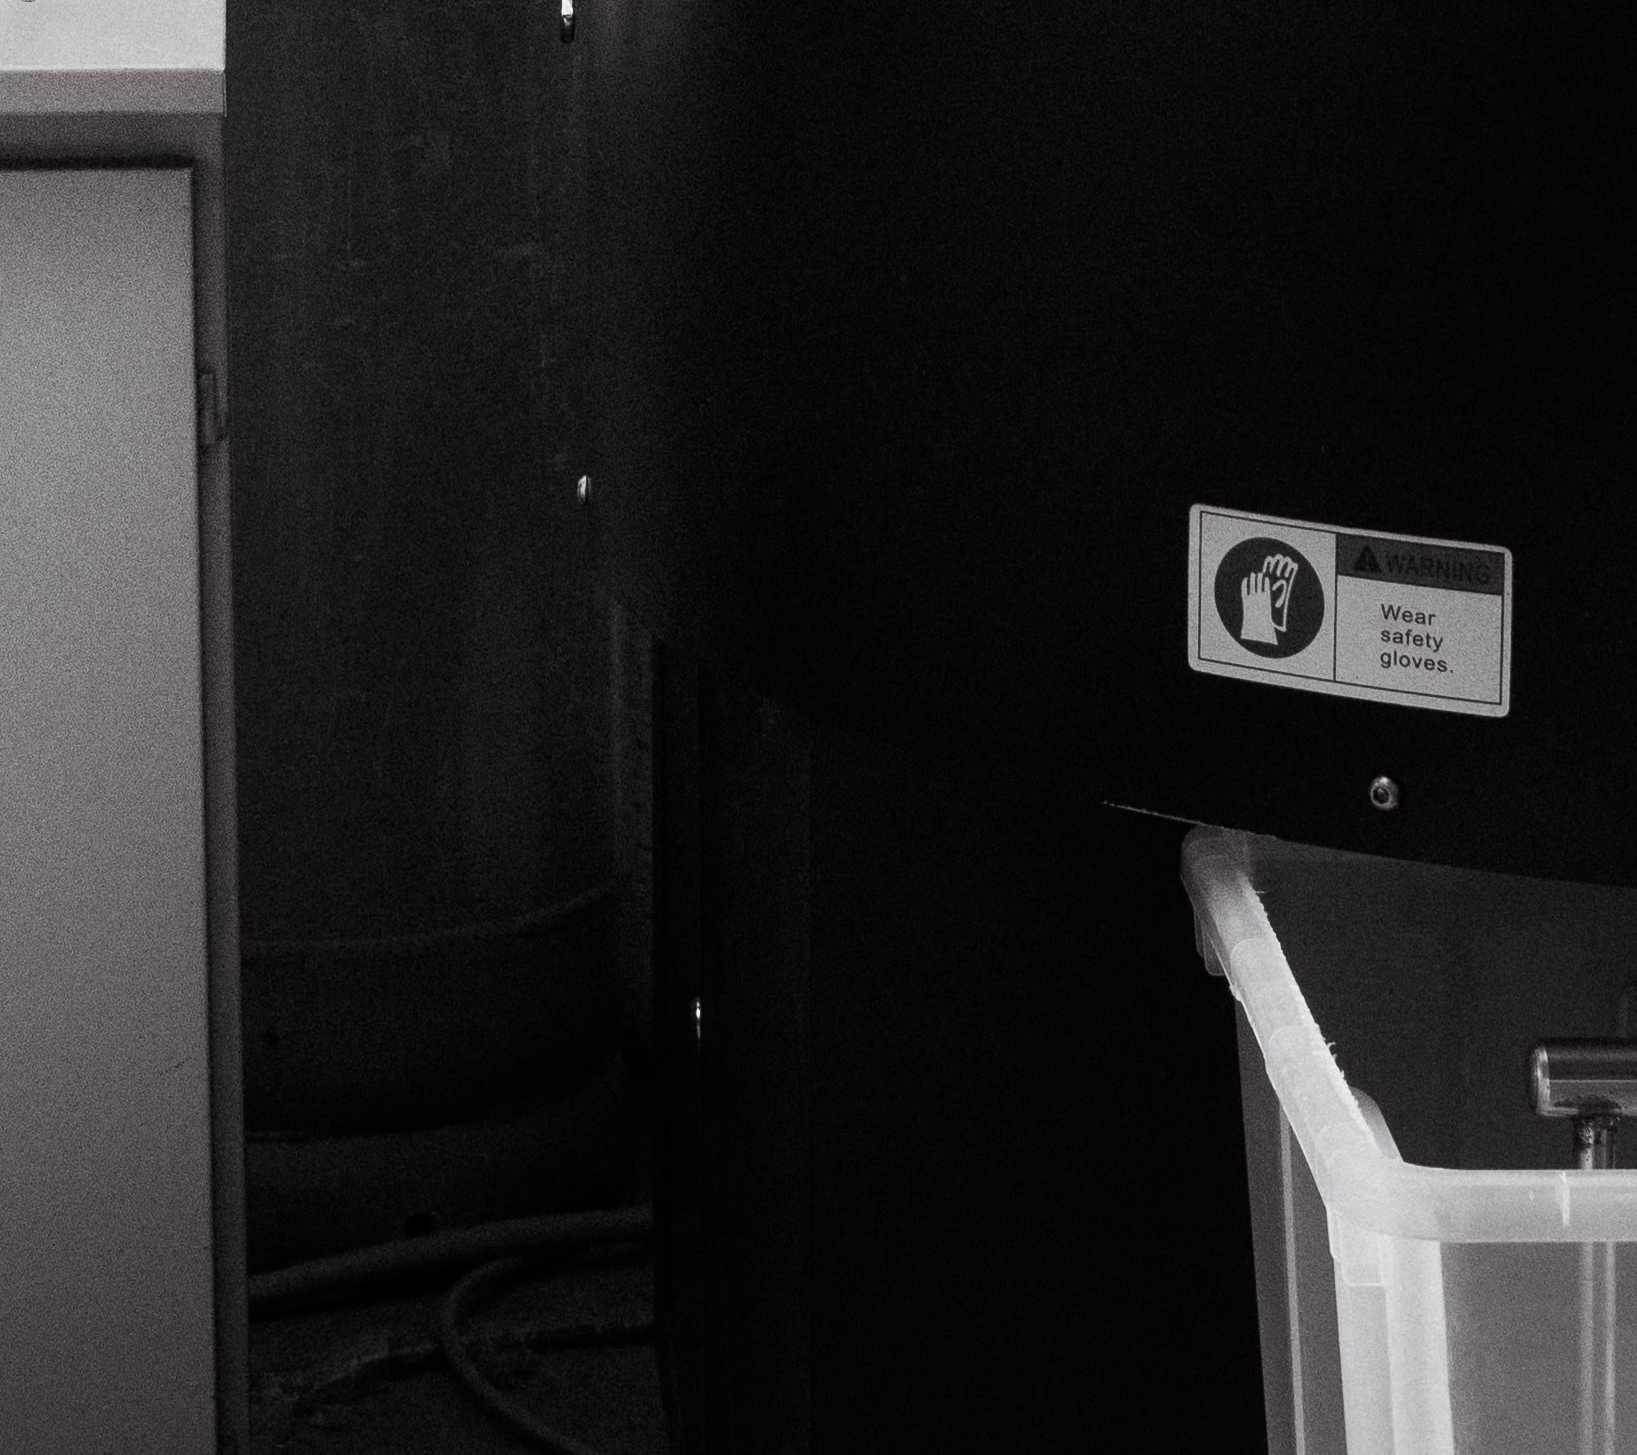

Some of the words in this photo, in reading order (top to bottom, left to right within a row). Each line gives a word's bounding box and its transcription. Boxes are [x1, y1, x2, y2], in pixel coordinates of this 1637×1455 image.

[1387, 553, 1491, 585] WARNING
[1380, 603, 1436, 626] Wear
[1380, 629, 1444, 653] safety
[1379, 650, 1454, 674] gloves.
